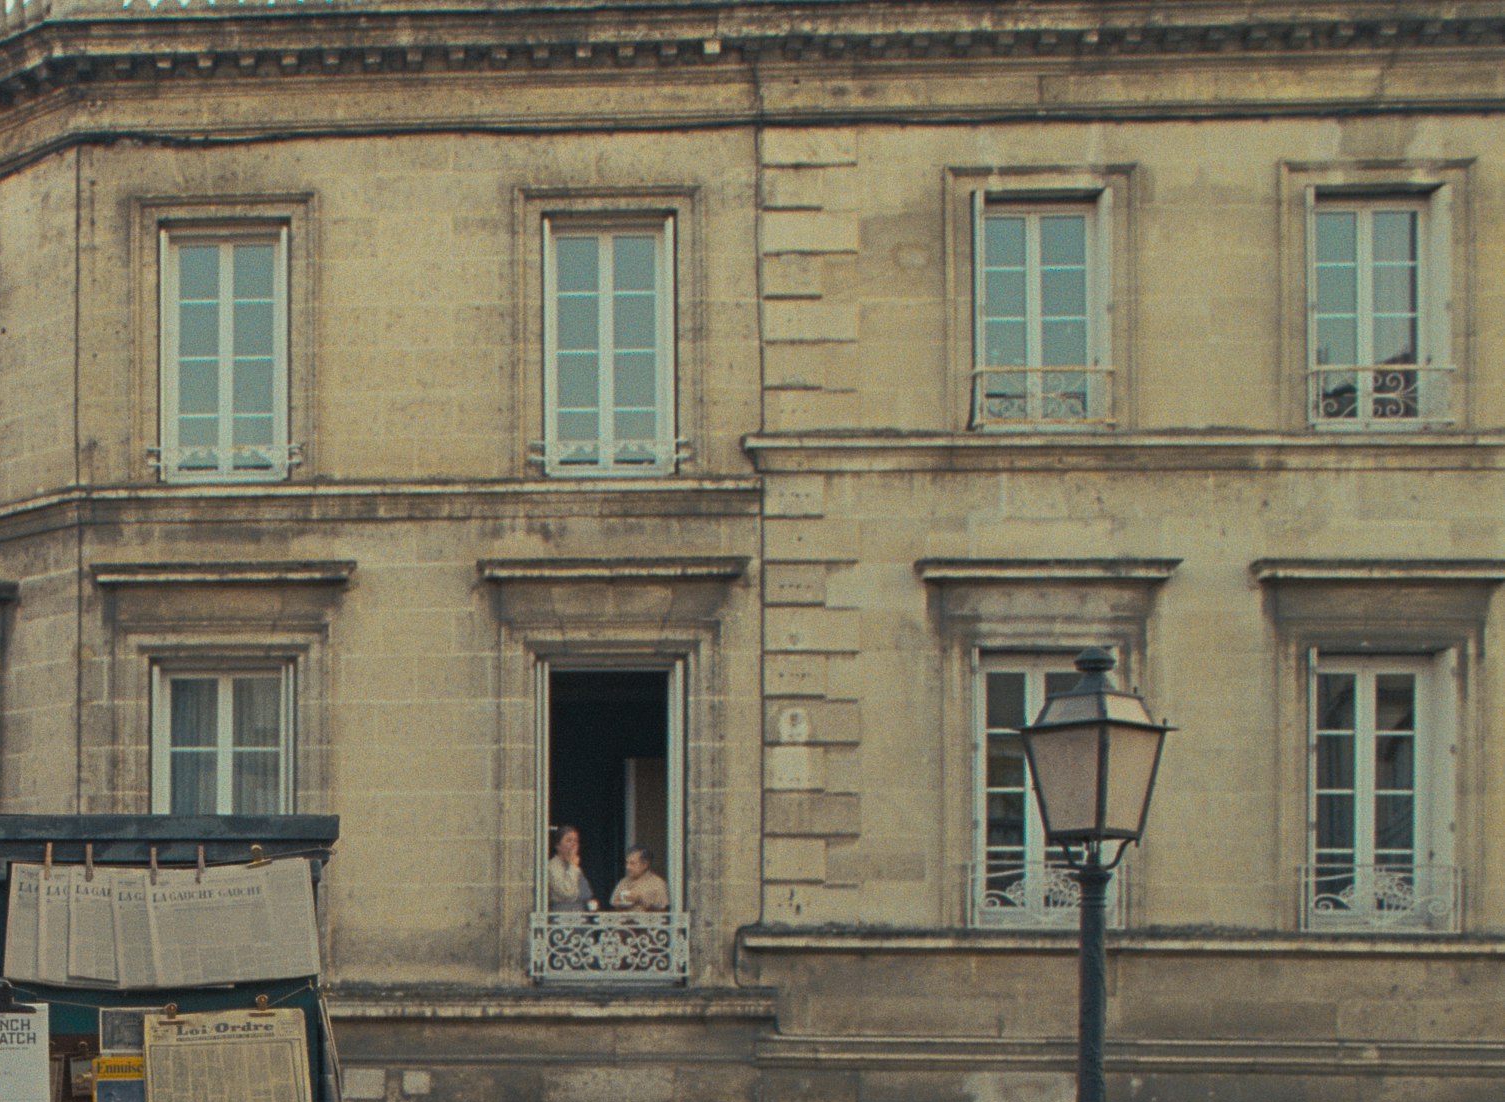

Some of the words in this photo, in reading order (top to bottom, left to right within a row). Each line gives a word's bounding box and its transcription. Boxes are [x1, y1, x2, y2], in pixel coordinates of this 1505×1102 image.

[152, 889, 167, 902] LA
[168, 888, 213, 901] GAUCHE
[217, 885, 262, 897] GAUCHE
[176, 1024, 208, 1036] Loi
[214, 1021, 275, 1034] Ordre
